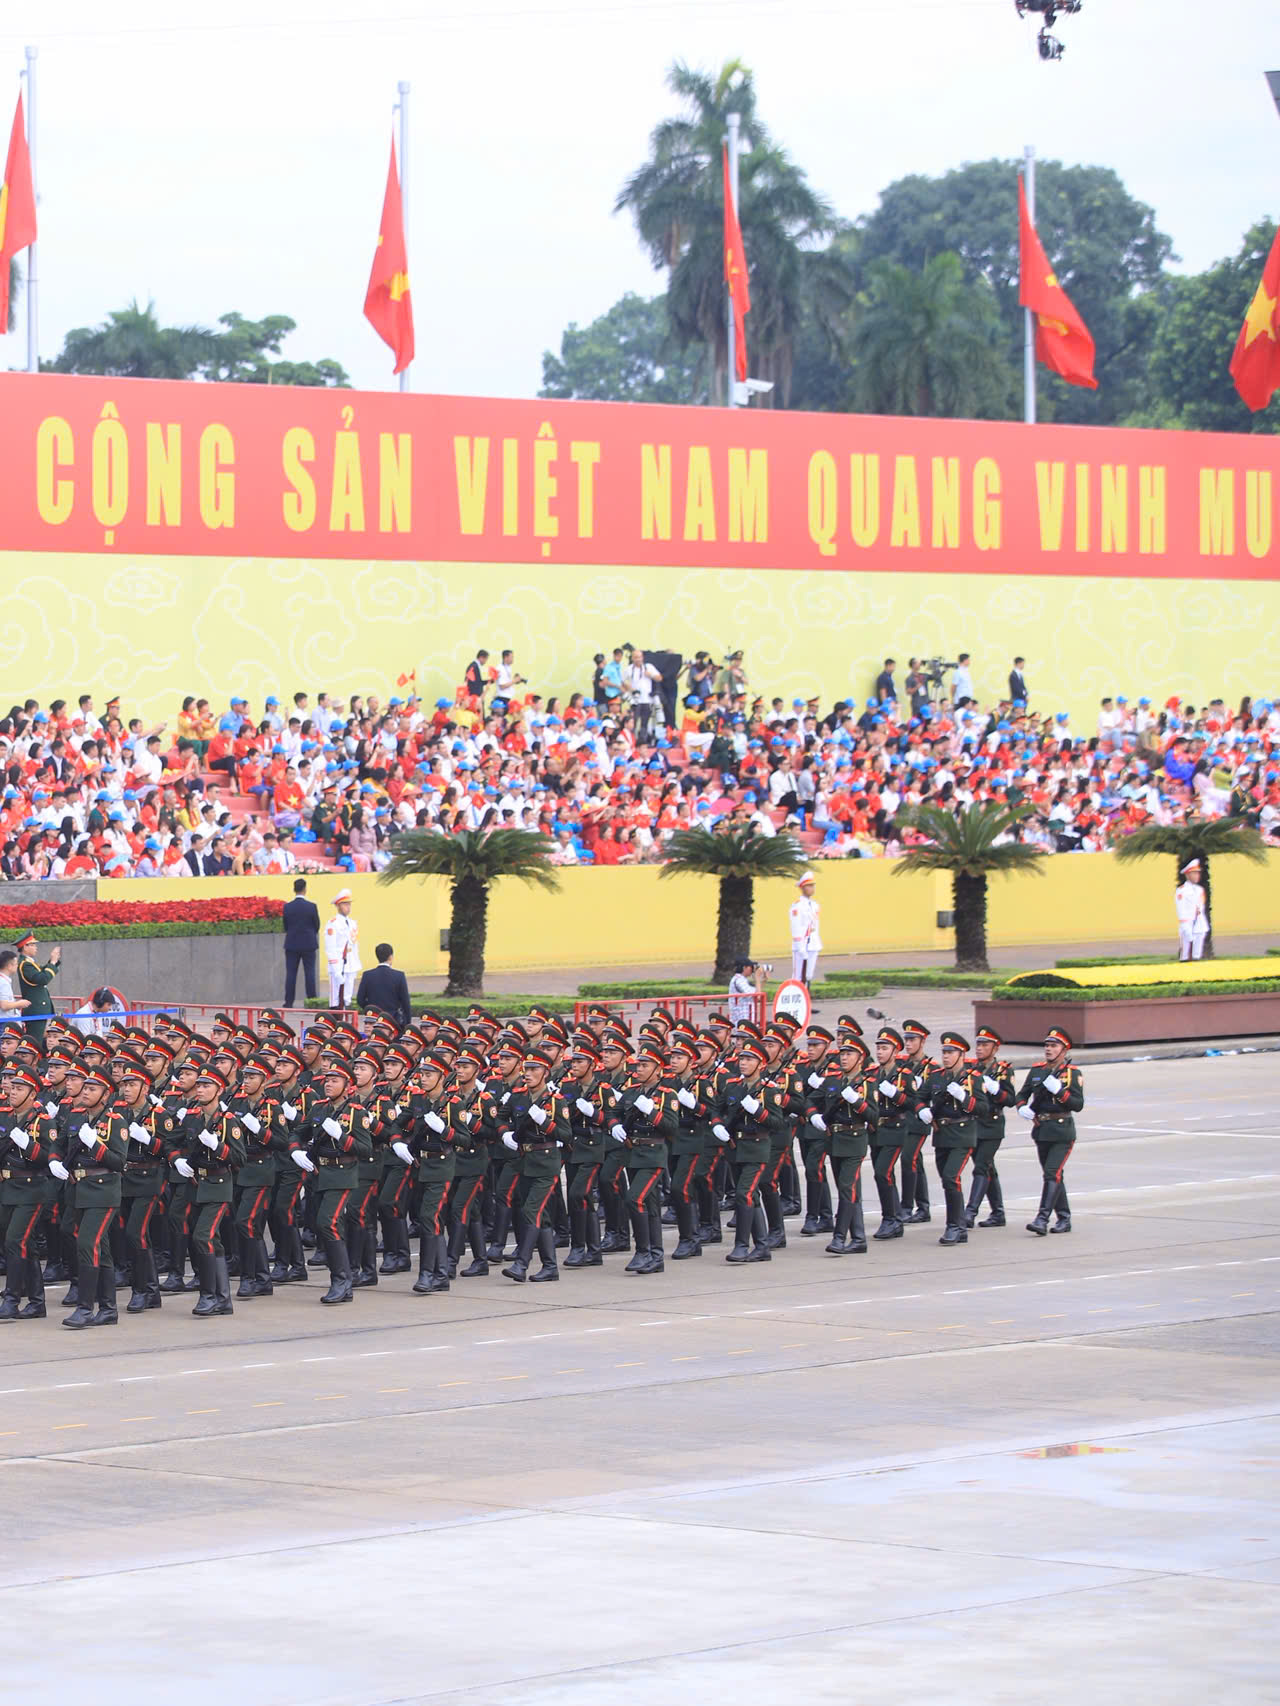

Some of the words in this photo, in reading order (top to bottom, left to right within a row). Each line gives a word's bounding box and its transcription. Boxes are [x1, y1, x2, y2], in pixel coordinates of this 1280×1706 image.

[36, 400, 236, 546] CỘNG
[282, 405, 412, 533] SẢN
[453, 421, 601, 557] VIỆT
[640, 443, 769, 543] NAM
[807, 449, 1001, 556] QUANG
[1034, 460, 1166, 554] VINH
